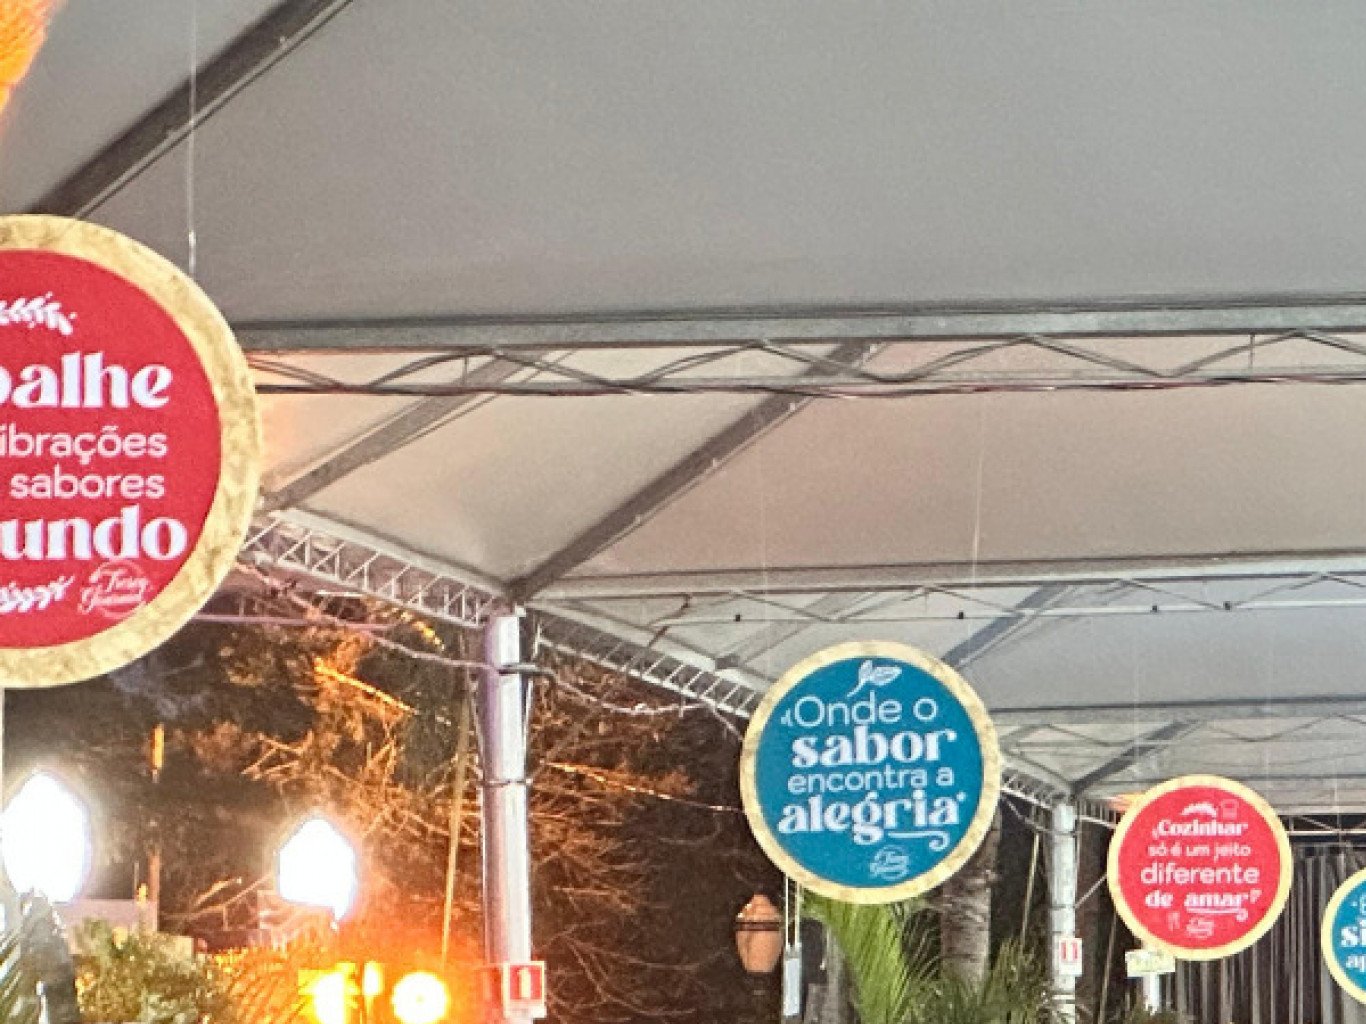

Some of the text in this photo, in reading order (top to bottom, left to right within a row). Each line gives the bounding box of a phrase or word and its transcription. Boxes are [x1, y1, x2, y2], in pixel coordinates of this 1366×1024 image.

[9, 465, 165, 500] sabores
[793, 690, 938, 727] Onde o
[792, 725, 957, 768] sabor
[787, 763, 955, 794] encontra a
[778, 790, 960, 845] alegria
[1156, 819, 1248, 837] Cozinhar
[1147, 842, 1167, 857] só
[1186, 844, 1210, 857] um
[1213, 842, 1251, 863] jeito
[1140, 861, 1260, 884] diferente
[1145, 890, 1249, 908] de amar
